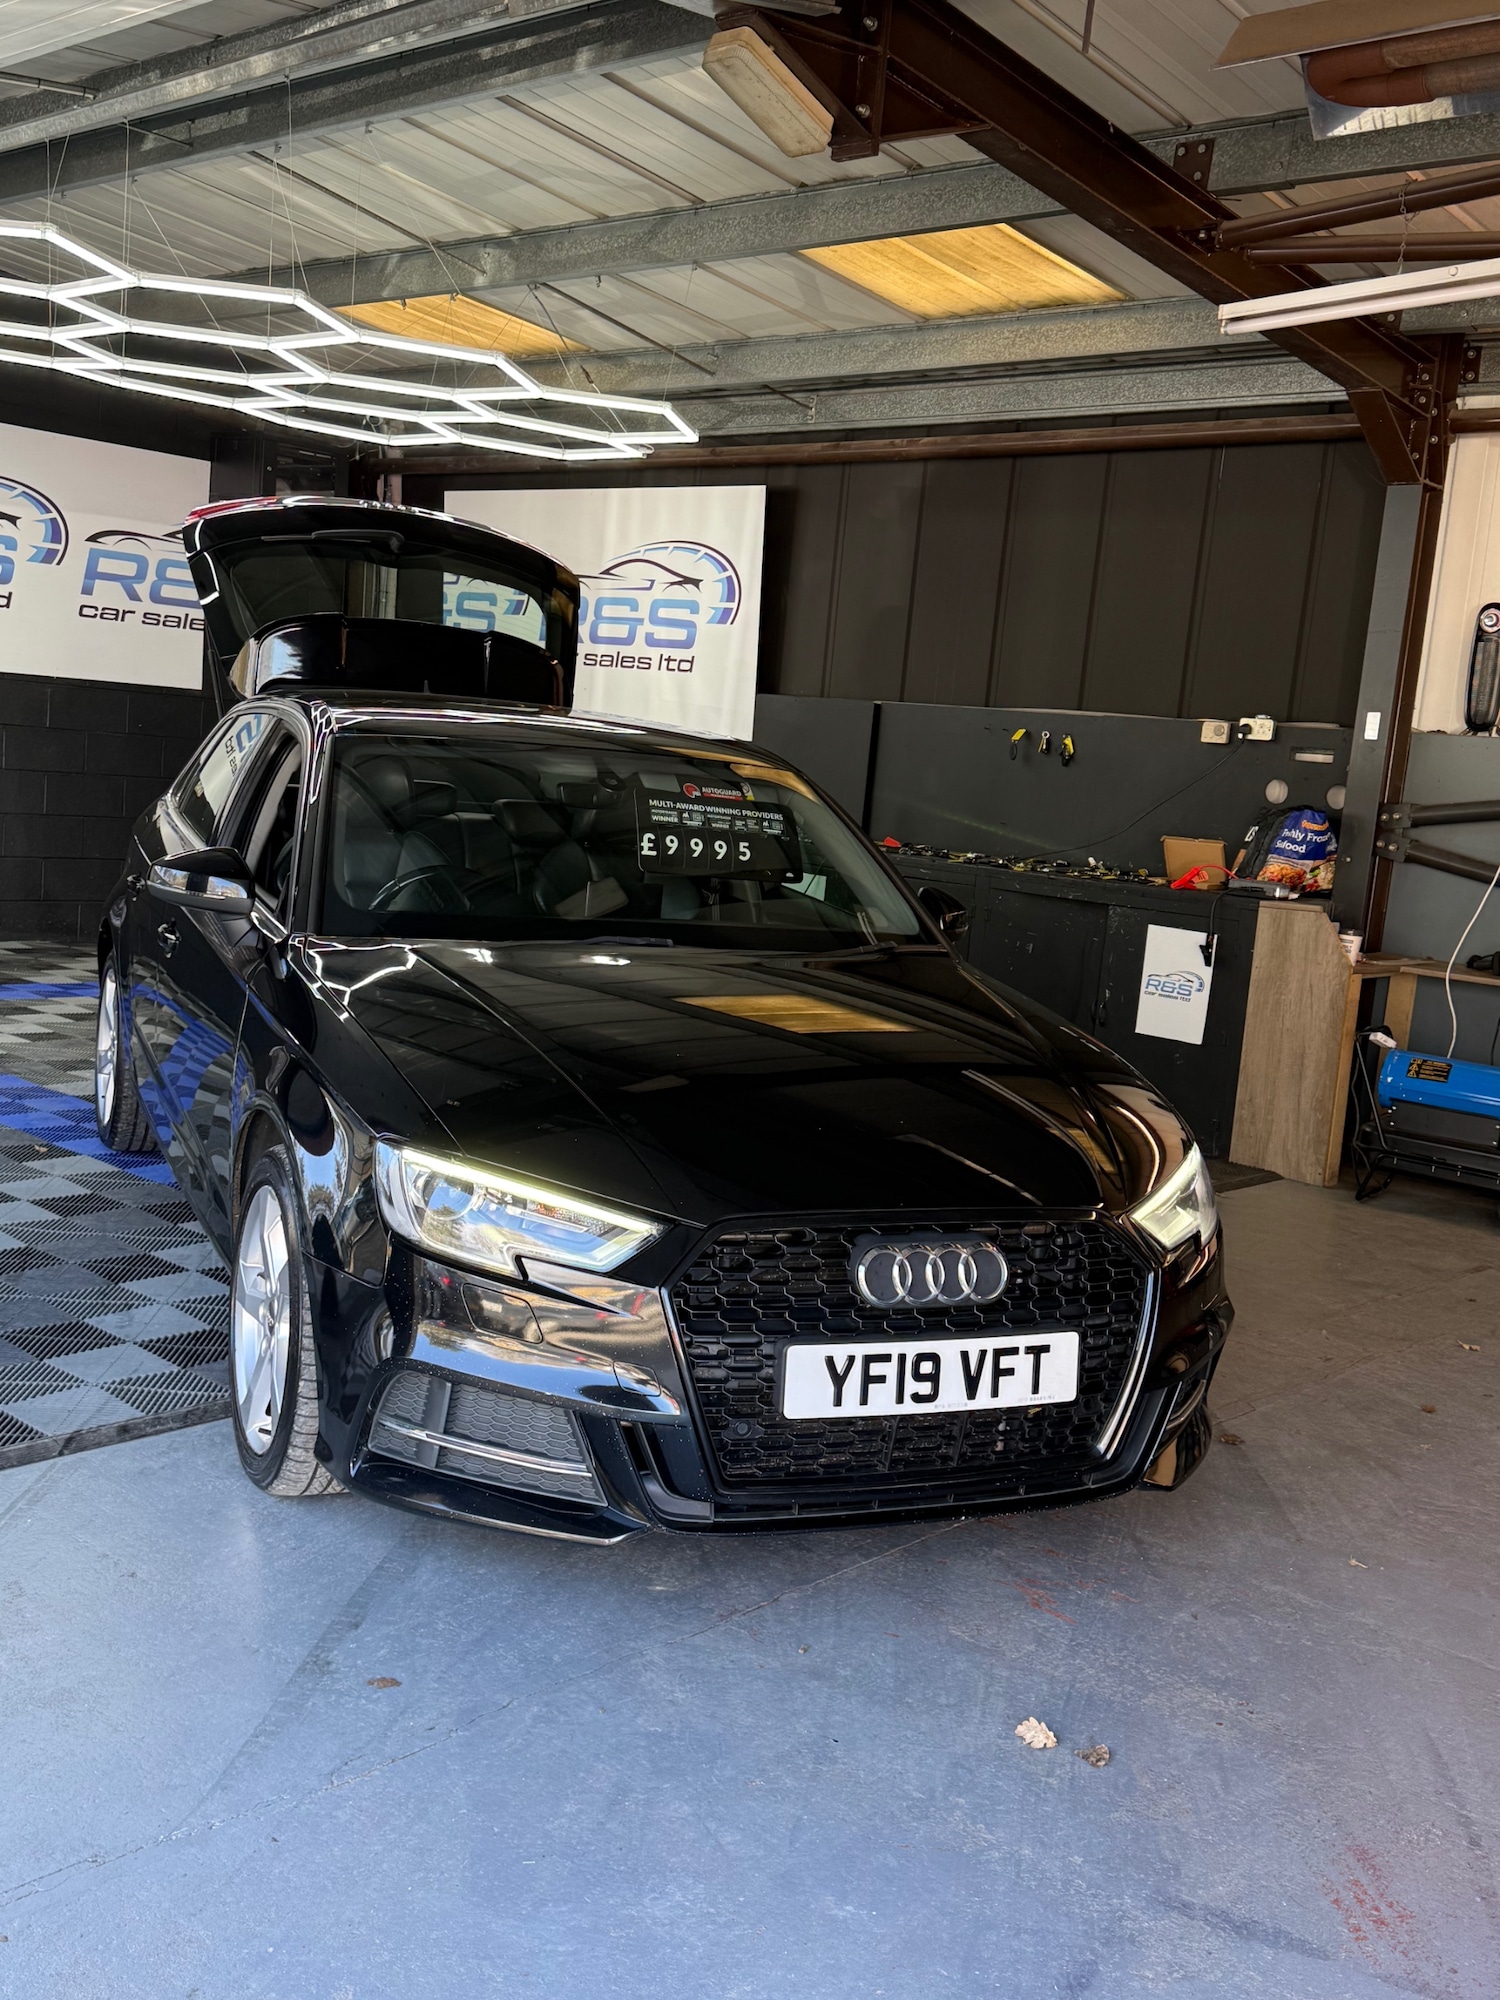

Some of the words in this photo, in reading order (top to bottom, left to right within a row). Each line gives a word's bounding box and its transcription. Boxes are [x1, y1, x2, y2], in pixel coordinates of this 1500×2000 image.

[79, 547, 202, 609] R&
[78, 604, 136, 623] car
[141, 608, 206, 631] sale
[583, 651, 652, 670] sales
[658, 653, 695, 673] ltd
[701, 786, 742, 797] AUTOGUARD
[651, 815, 679, 824] WINNER
[742, 810, 784, 821] PROVIDERS
[1306, 832, 1331, 843] Froz
[1145, 978, 1193, 996] R&S
[824, 1352, 942, 1407] YF19
[959, 1345, 1051, 1400] VFT
